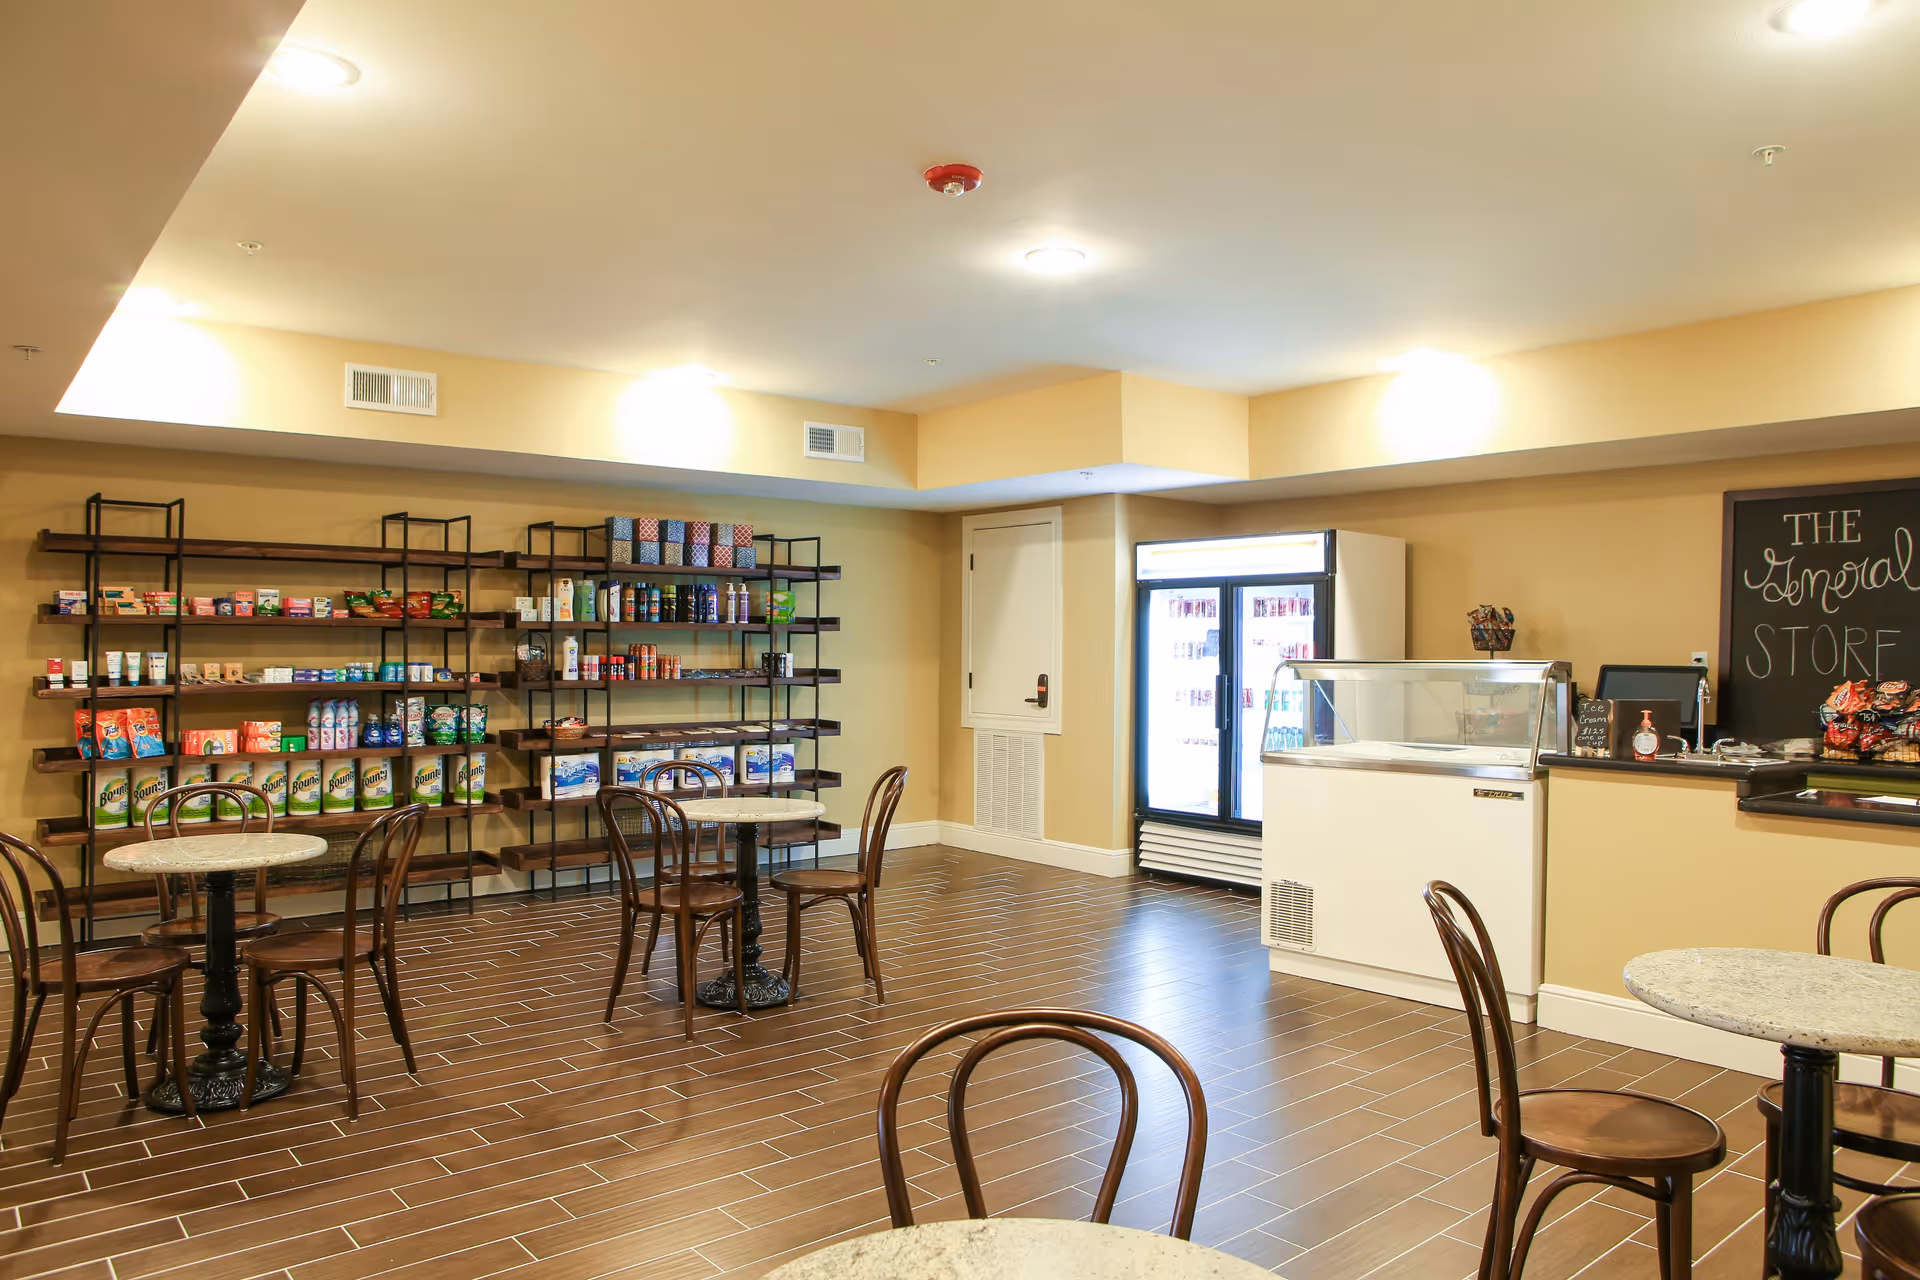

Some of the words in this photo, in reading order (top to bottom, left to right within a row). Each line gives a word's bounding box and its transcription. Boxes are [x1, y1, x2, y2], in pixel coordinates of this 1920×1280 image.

[1783, 509, 1861, 546] THE
[1744, 527, 1920, 613] General
[1746, 623, 1901, 681] STORE
[1579, 714, 1607, 725] Cream
[1580, 702, 1605, 713] Ice
